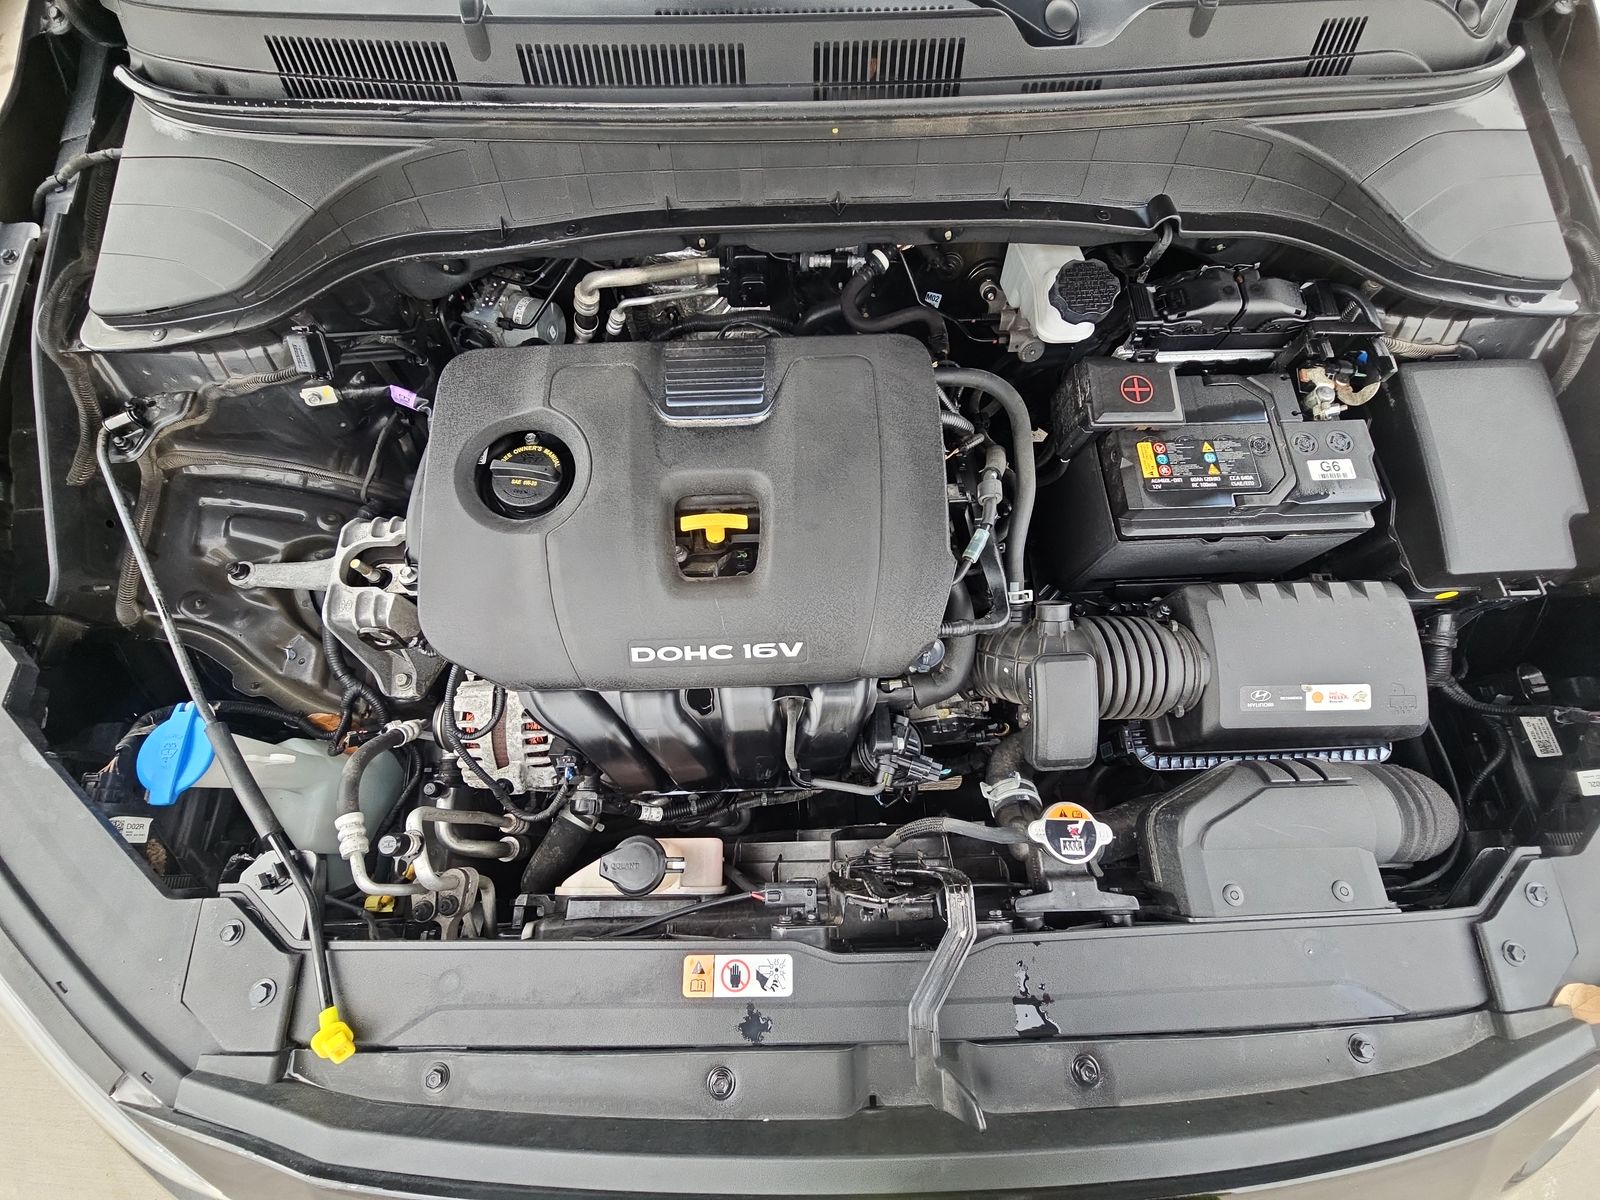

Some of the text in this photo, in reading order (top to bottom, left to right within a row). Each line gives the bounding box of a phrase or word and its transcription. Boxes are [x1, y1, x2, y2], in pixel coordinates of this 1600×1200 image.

[500, 445, 561, 468] SEE OWNER'S MANUAL
[1320, 461, 1341, 472] G6
[630, 642, 804, 662] DOHC 16V
